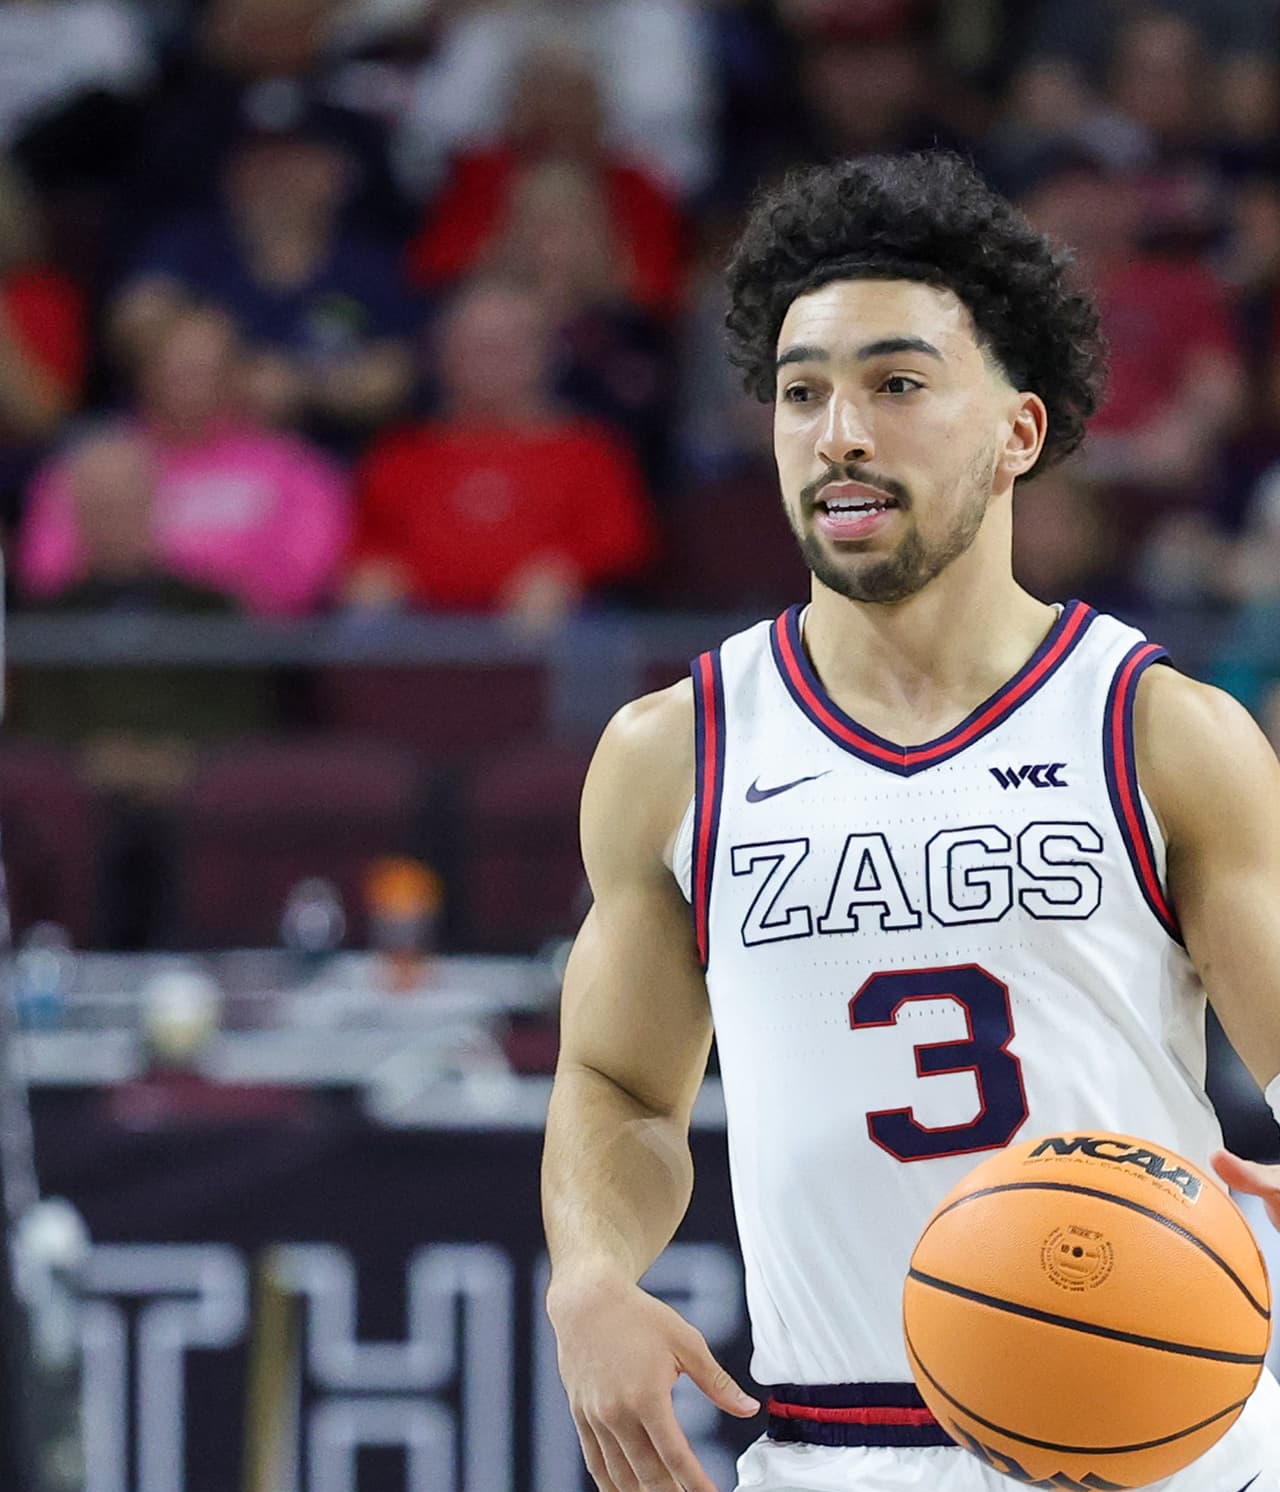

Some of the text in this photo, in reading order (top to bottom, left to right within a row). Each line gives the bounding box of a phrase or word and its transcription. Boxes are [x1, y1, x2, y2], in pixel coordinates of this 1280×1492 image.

[988, 762, 1069, 791] WCC
[730, 821, 1104, 947] ZAGS
[847, 963, 1030, 1163] 3
[1027, 1136, 1202, 1205] NCAA
